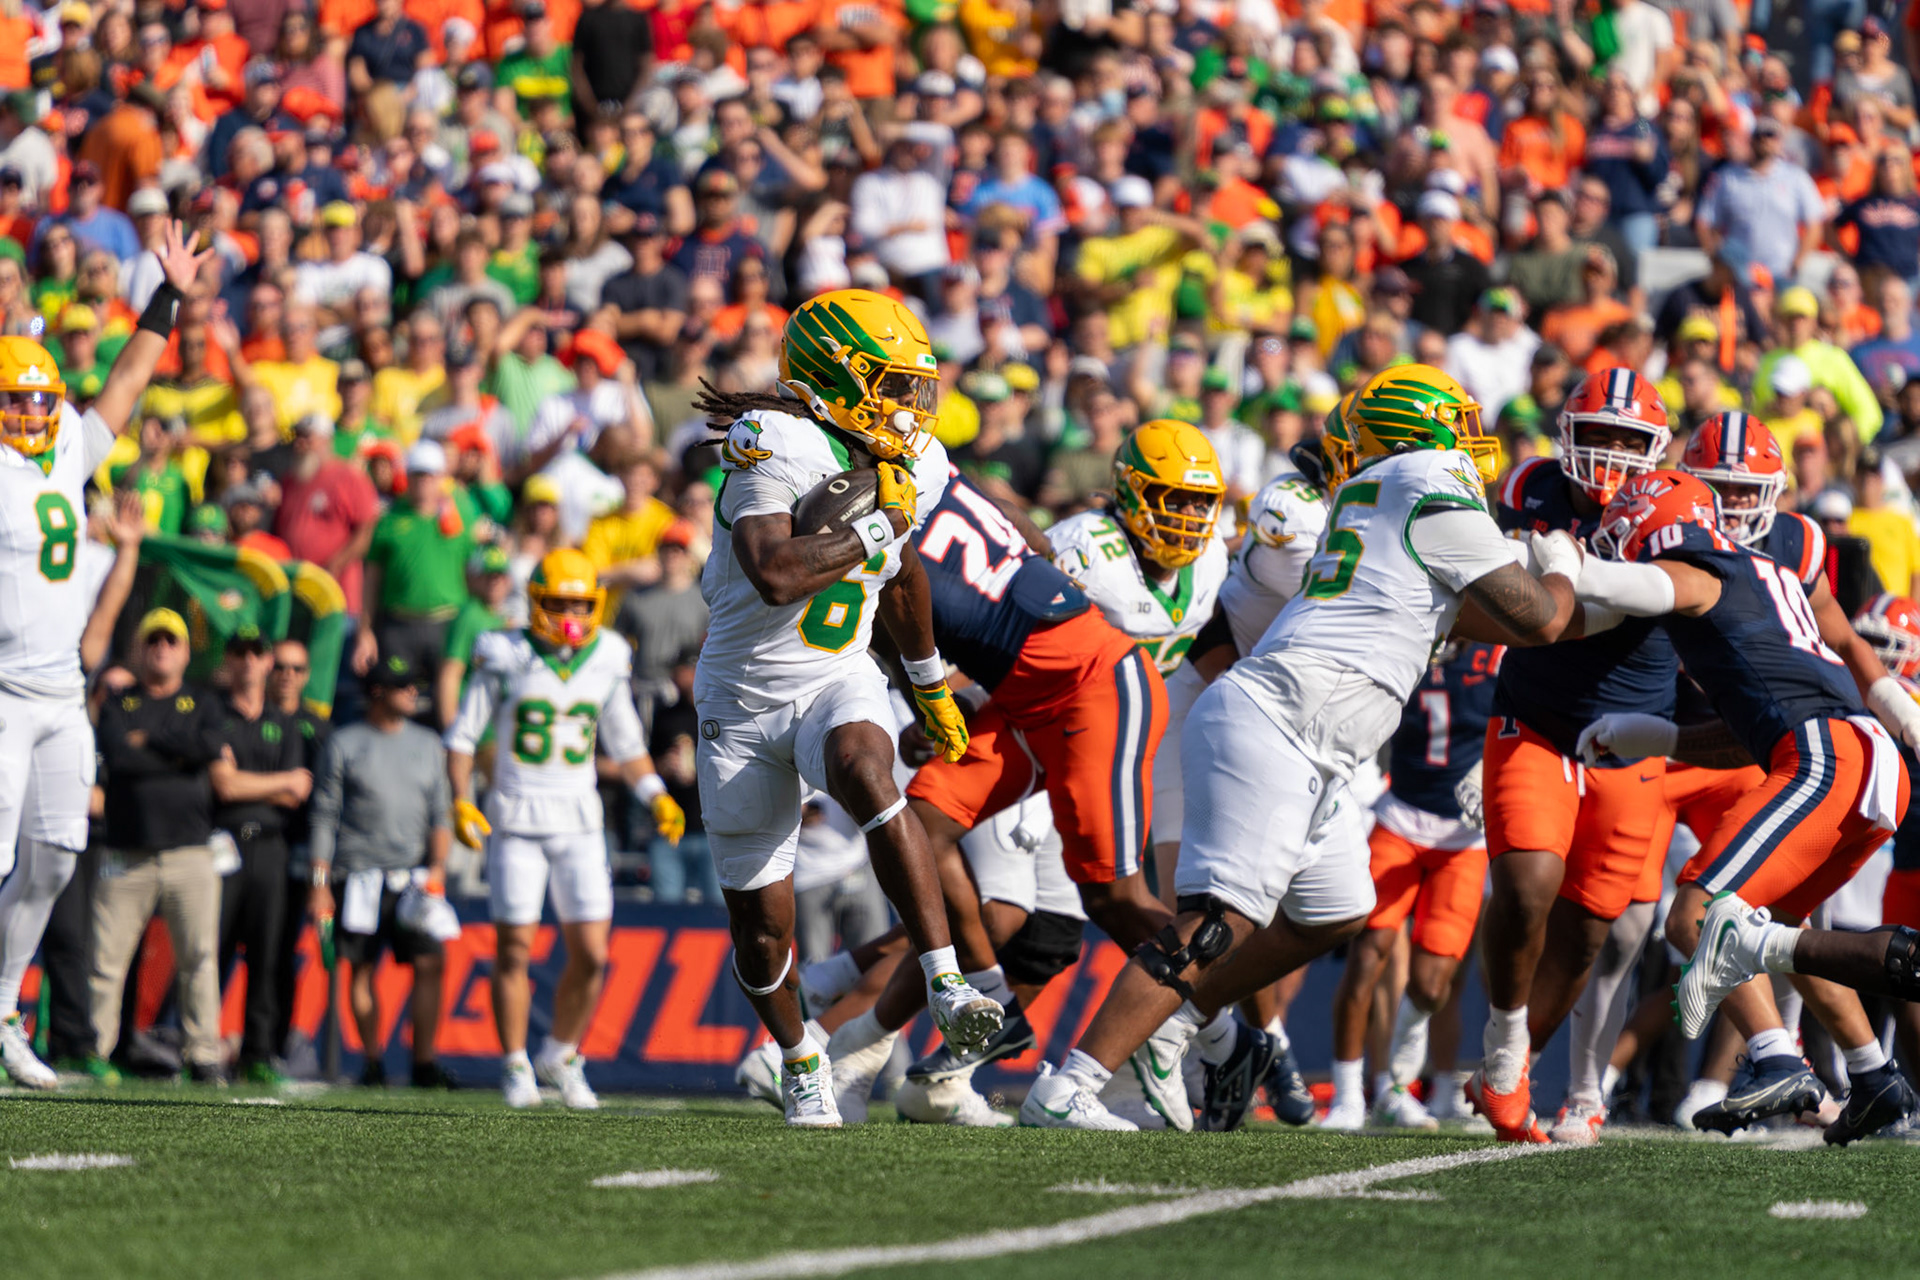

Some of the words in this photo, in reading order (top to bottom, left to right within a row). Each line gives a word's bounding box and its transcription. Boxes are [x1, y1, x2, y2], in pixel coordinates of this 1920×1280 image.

[1611, 479, 1673, 508] ILLINI
[34, 491, 79, 583] 8
[918, 480, 1028, 602] 24
[1088, 516, 1128, 561] 72
[1649, 523, 1684, 557] 10
[797, 549, 888, 654] 6
[1750, 555, 1845, 666] 10
[513, 698, 597, 765] 83
[701, 719, 720, 740] O
[1420, 690, 1451, 766] 1
